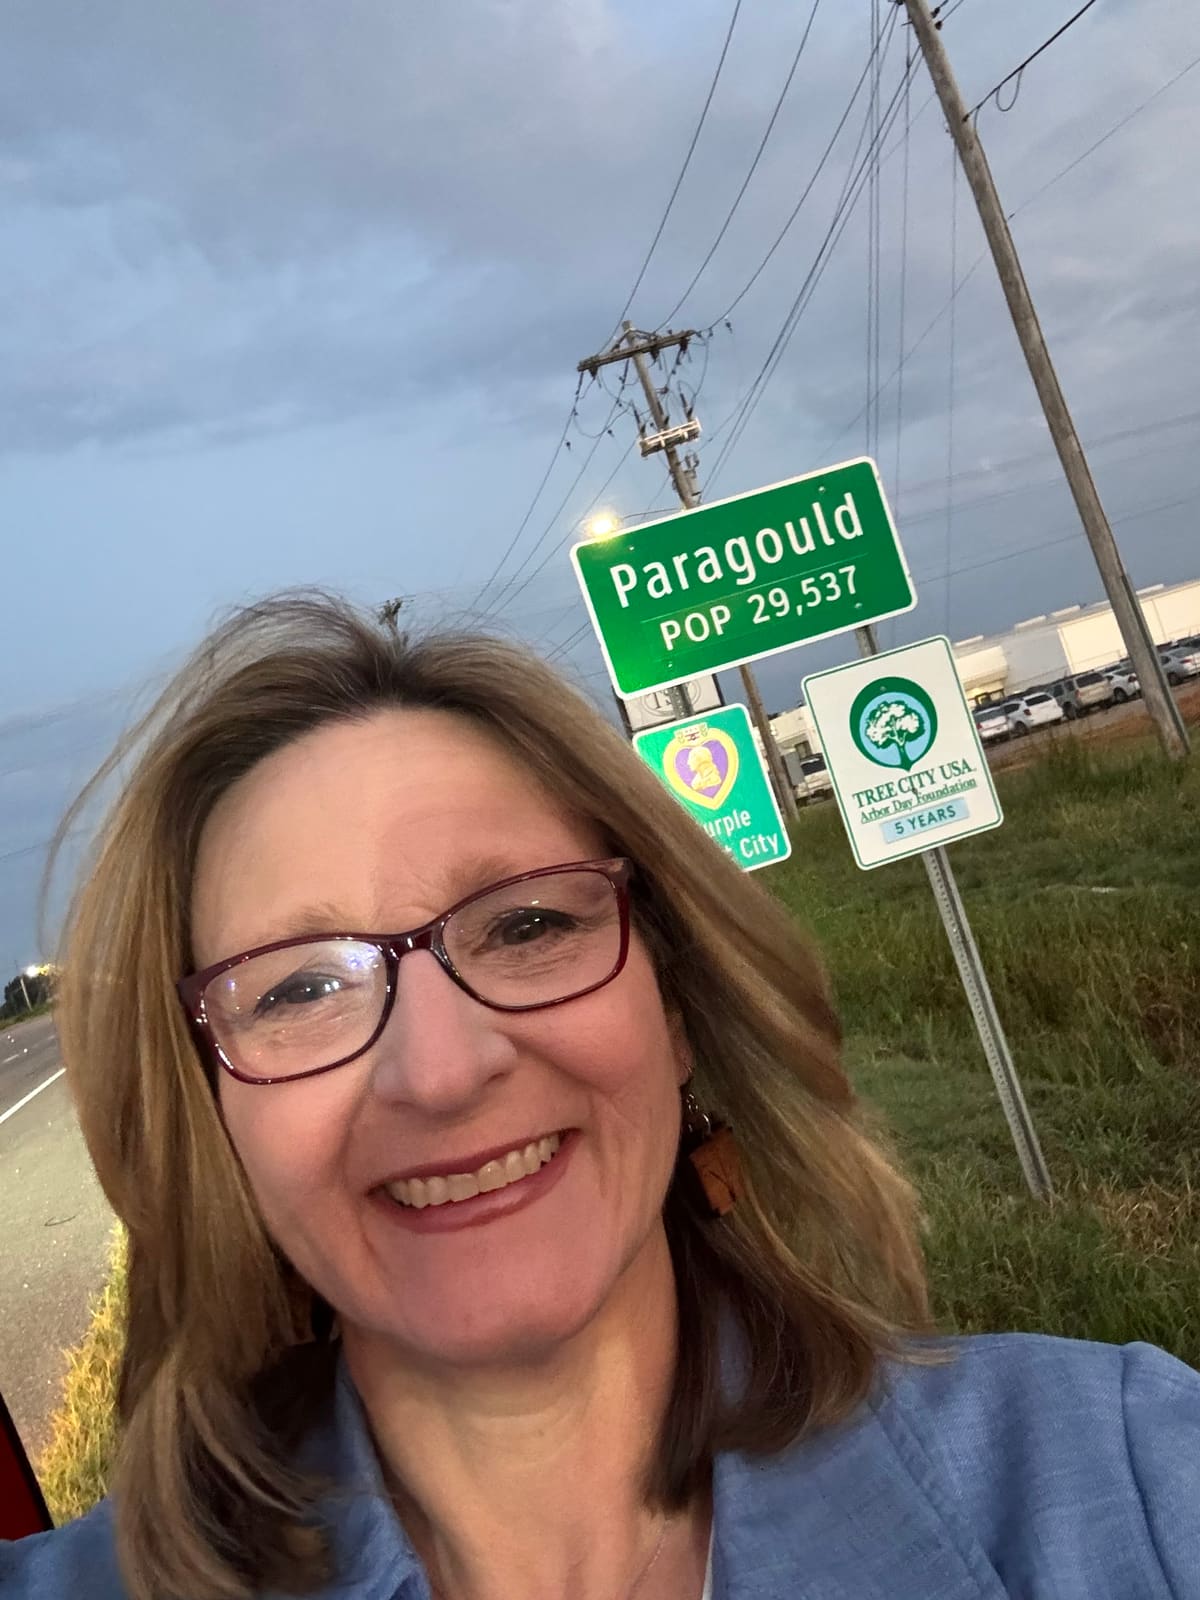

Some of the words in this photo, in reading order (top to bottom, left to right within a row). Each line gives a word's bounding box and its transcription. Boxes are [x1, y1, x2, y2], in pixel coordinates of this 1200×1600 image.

[609, 492, 864, 608] Paragould
[659, 605, 732, 651] POP
[746, 565, 857, 624] 29,537
[852, 782, 898, 808] TREE
[898, 768, 936, 794] CITY
[939, 758, 973, 780] USA
[861, 805, 890, 823] Arbor
[893, 798, 913, 812] Day
[916, 778, 977, 804] Foundation
[703, 809, 751, 838] urple
[894, 822, 905, 834] 5
[907, 805, 956, 831] YEARS
[740, 833, 779, 858] City
